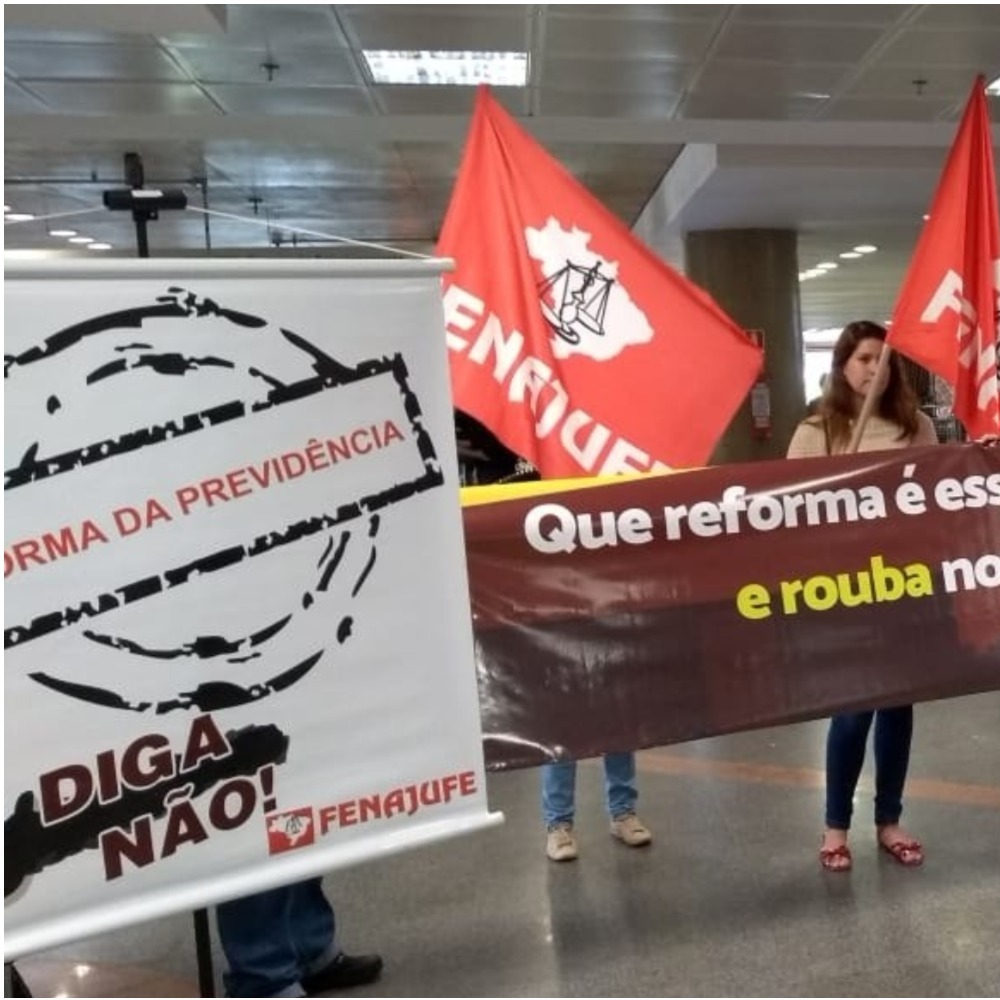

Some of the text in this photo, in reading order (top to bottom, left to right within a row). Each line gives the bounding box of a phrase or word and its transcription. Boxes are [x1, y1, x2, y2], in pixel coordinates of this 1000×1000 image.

[113, 498, 173, 537] DA
[175, 419, 406, 516] PREVIDÊNCIA
[524, 503, 654, 555] Que
[664, 485, 887, 541] reforma
[895, 464, 928, 515] é
[737, 583, 772, 619] e
[780, 555, 932, 615] rouba
[39, 714, 231, 826] DIGA
[320, 771, 477, 835] FENAJUFE
[99, 765, 277, 881] NÃO!
